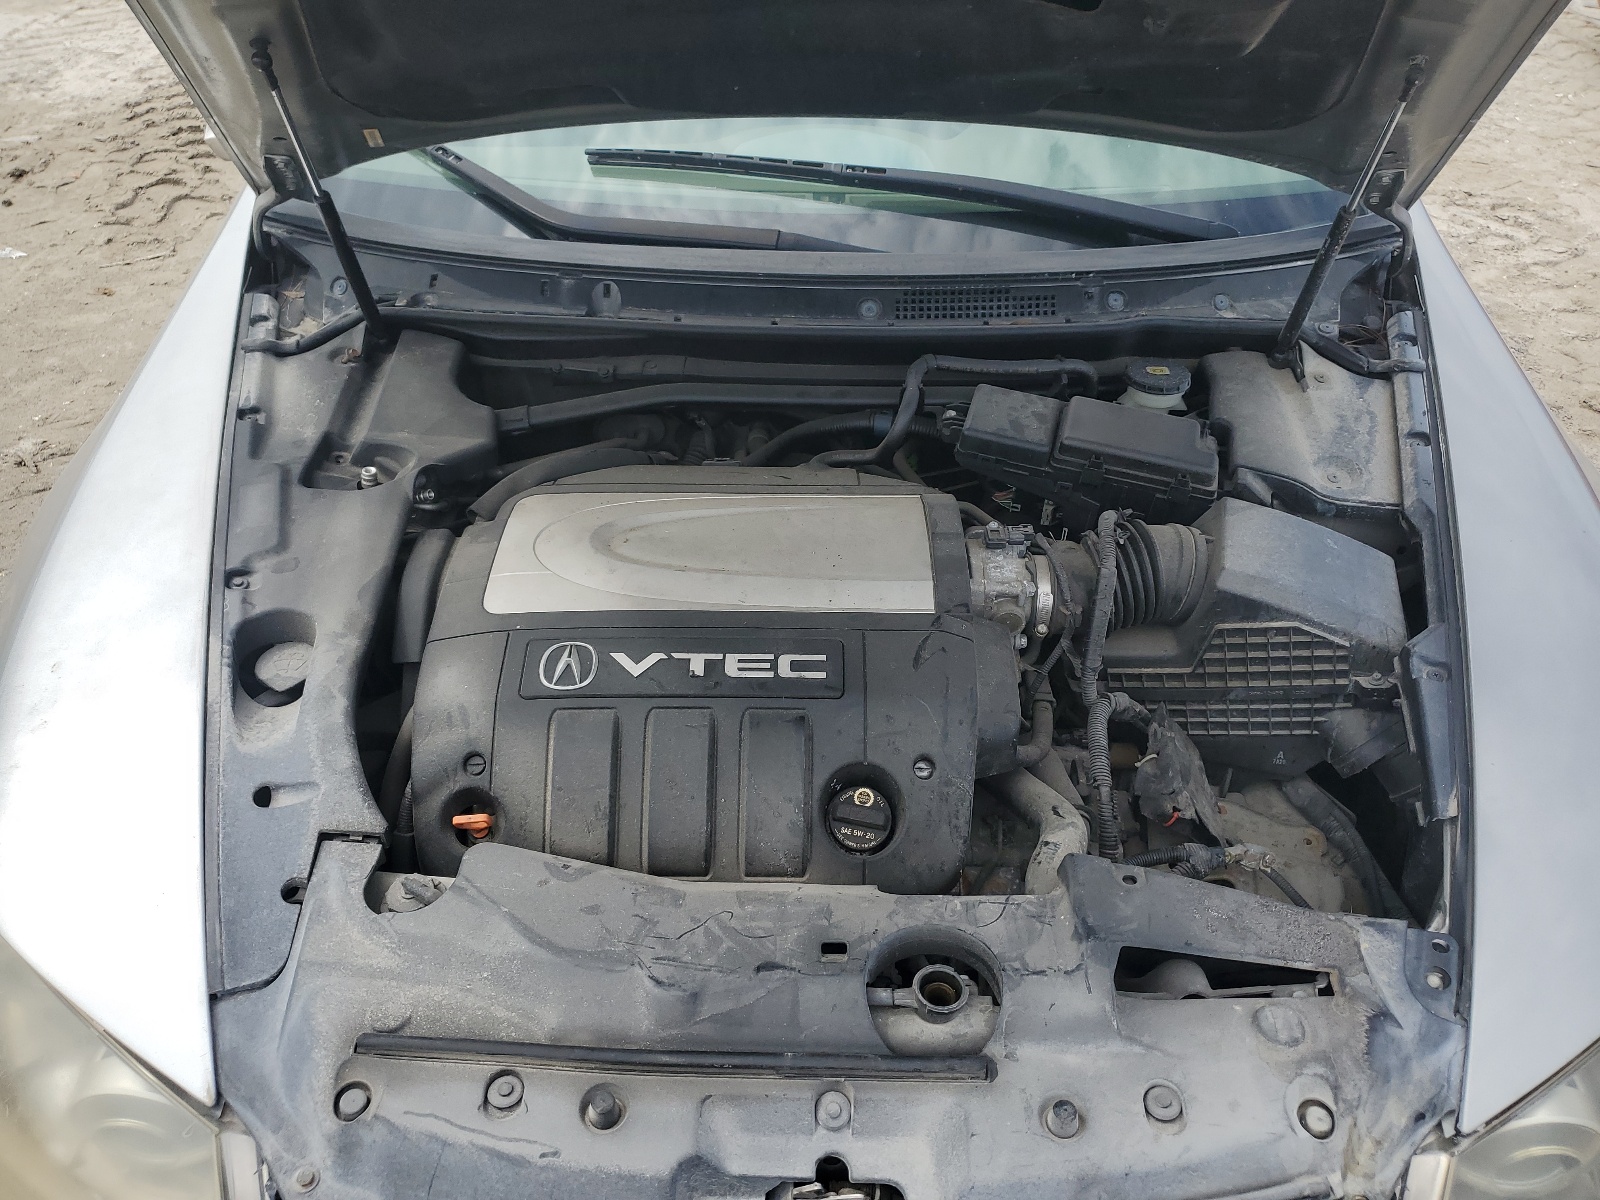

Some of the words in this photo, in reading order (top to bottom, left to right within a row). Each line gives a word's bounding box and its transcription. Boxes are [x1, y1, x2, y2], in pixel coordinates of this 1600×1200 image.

[609, 652, 827, 678] VTEC
[840, 826, 852, 835] SAE
[853, 829, 875, 840] 5W-20
